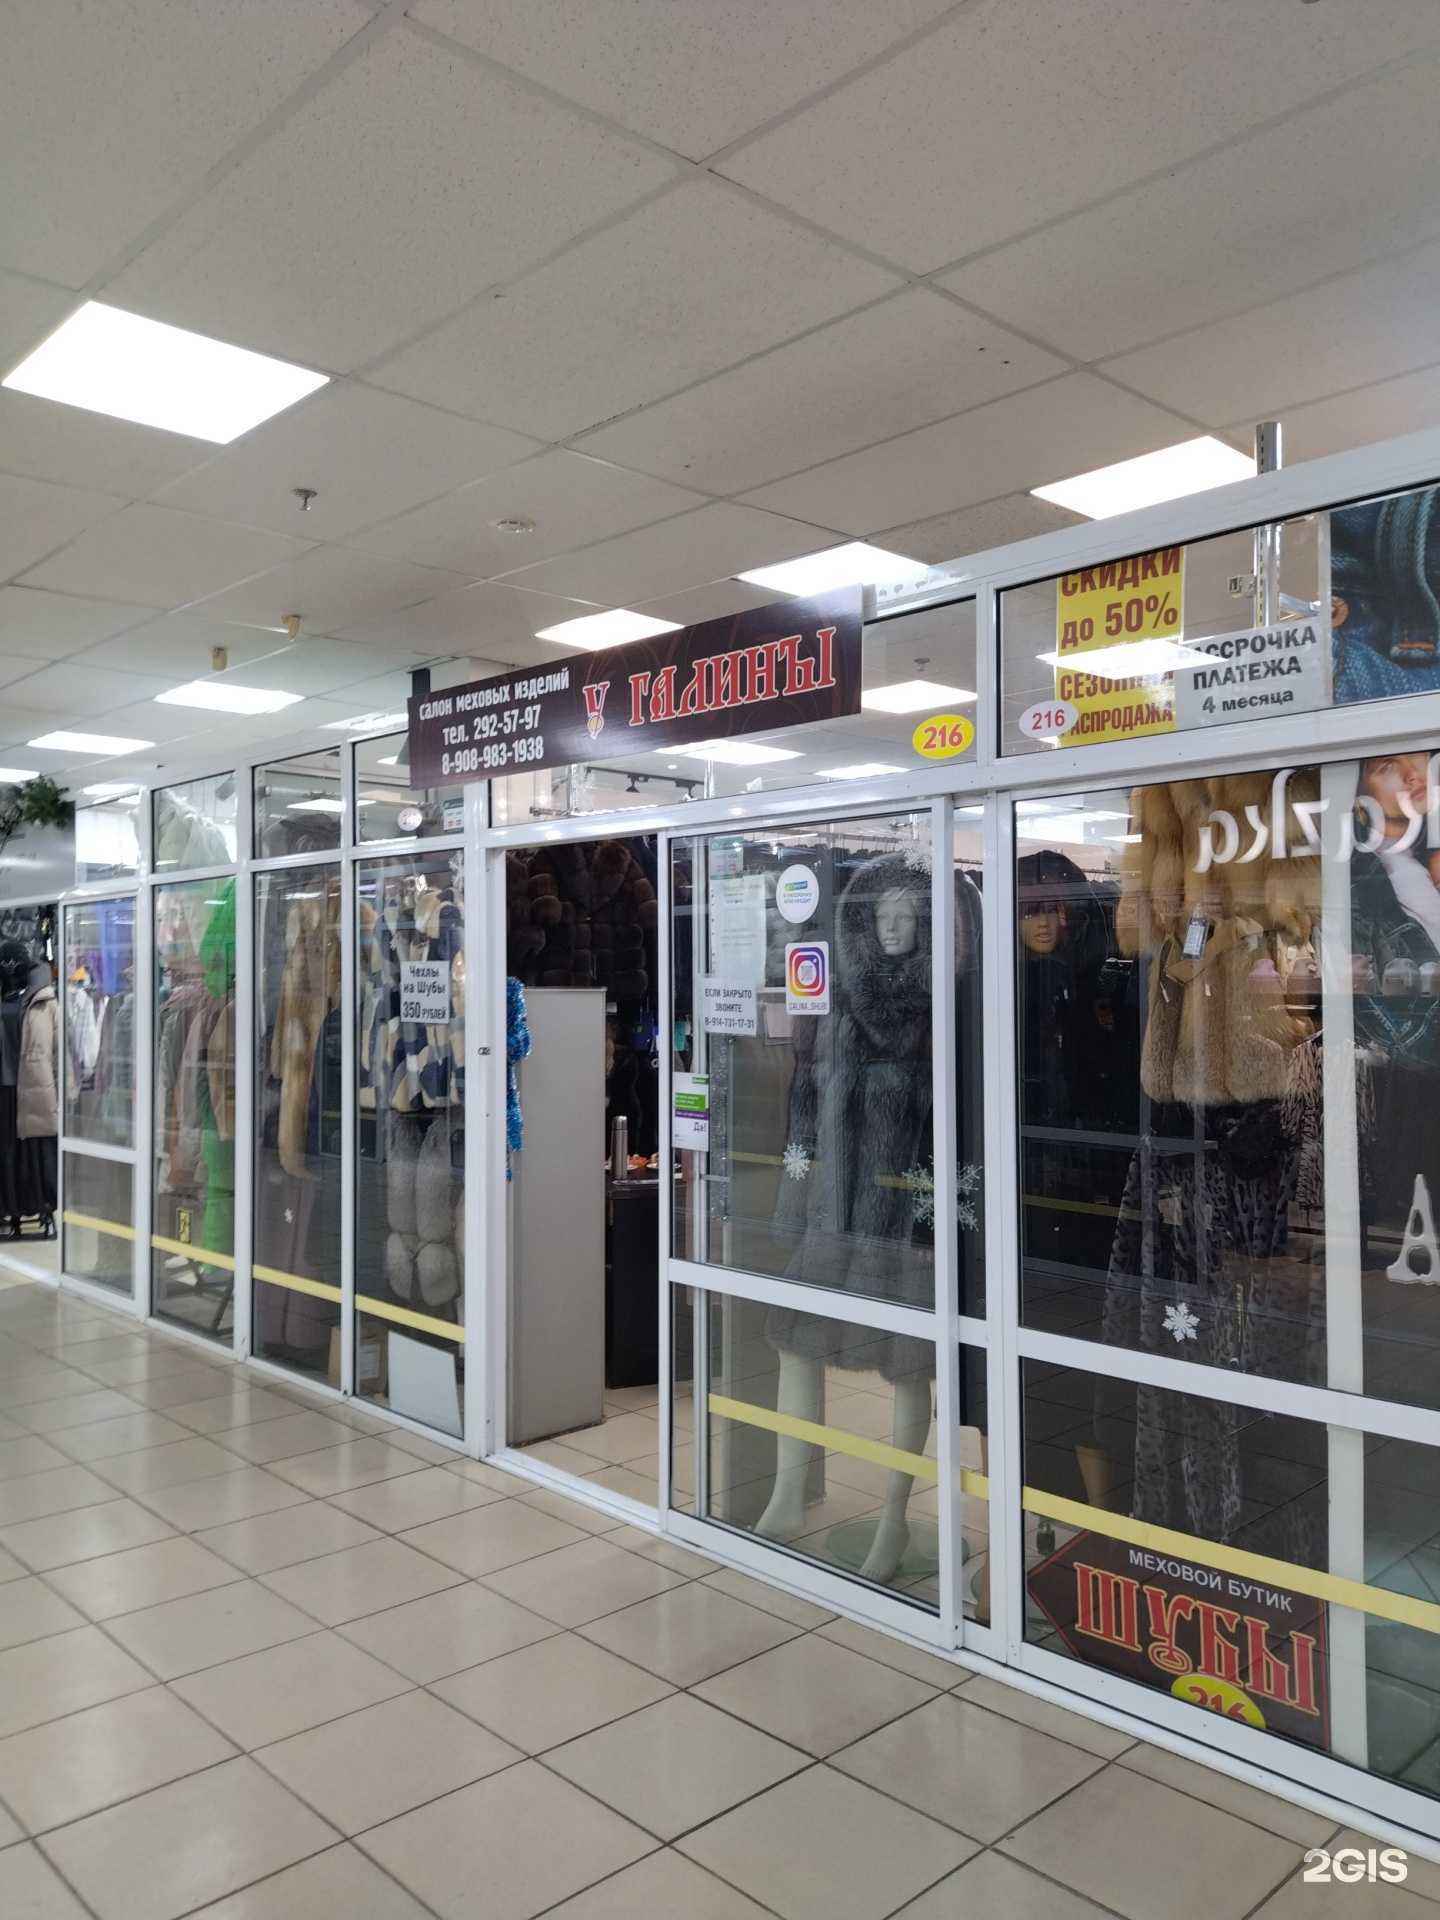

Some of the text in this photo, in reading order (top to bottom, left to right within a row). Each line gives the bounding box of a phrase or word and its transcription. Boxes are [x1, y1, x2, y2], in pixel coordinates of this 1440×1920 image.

[1061, 549, 1181, 597] СКИДКИ
[1105, 591, 1178, 636] 50%
[1178, 625, 1317, 661] ССРОЧКА
[456, 684, 511, 713] меховых
[514, 667, 570, 699] изделий
[1192, 655, 1302, 690] ПЛАТЕЖА
[1031, 708, 1066, 731] 216
[1202, 690, 1295, 714] 4 месяца
[442, 704, 542, 746] тел. 292-57-97
[922, 723, 964, 751] 216
[441, 735, 544, 775] 8-908-983-1938
[409, 966, 440, 978] Чехлы
[402, 1001, 421, 1018] 350
[1128, 1549, 1292, 1613] МЕХОВОЙ БУТИК
[1073, 1562, 1320, 1716] ШУБЫ
